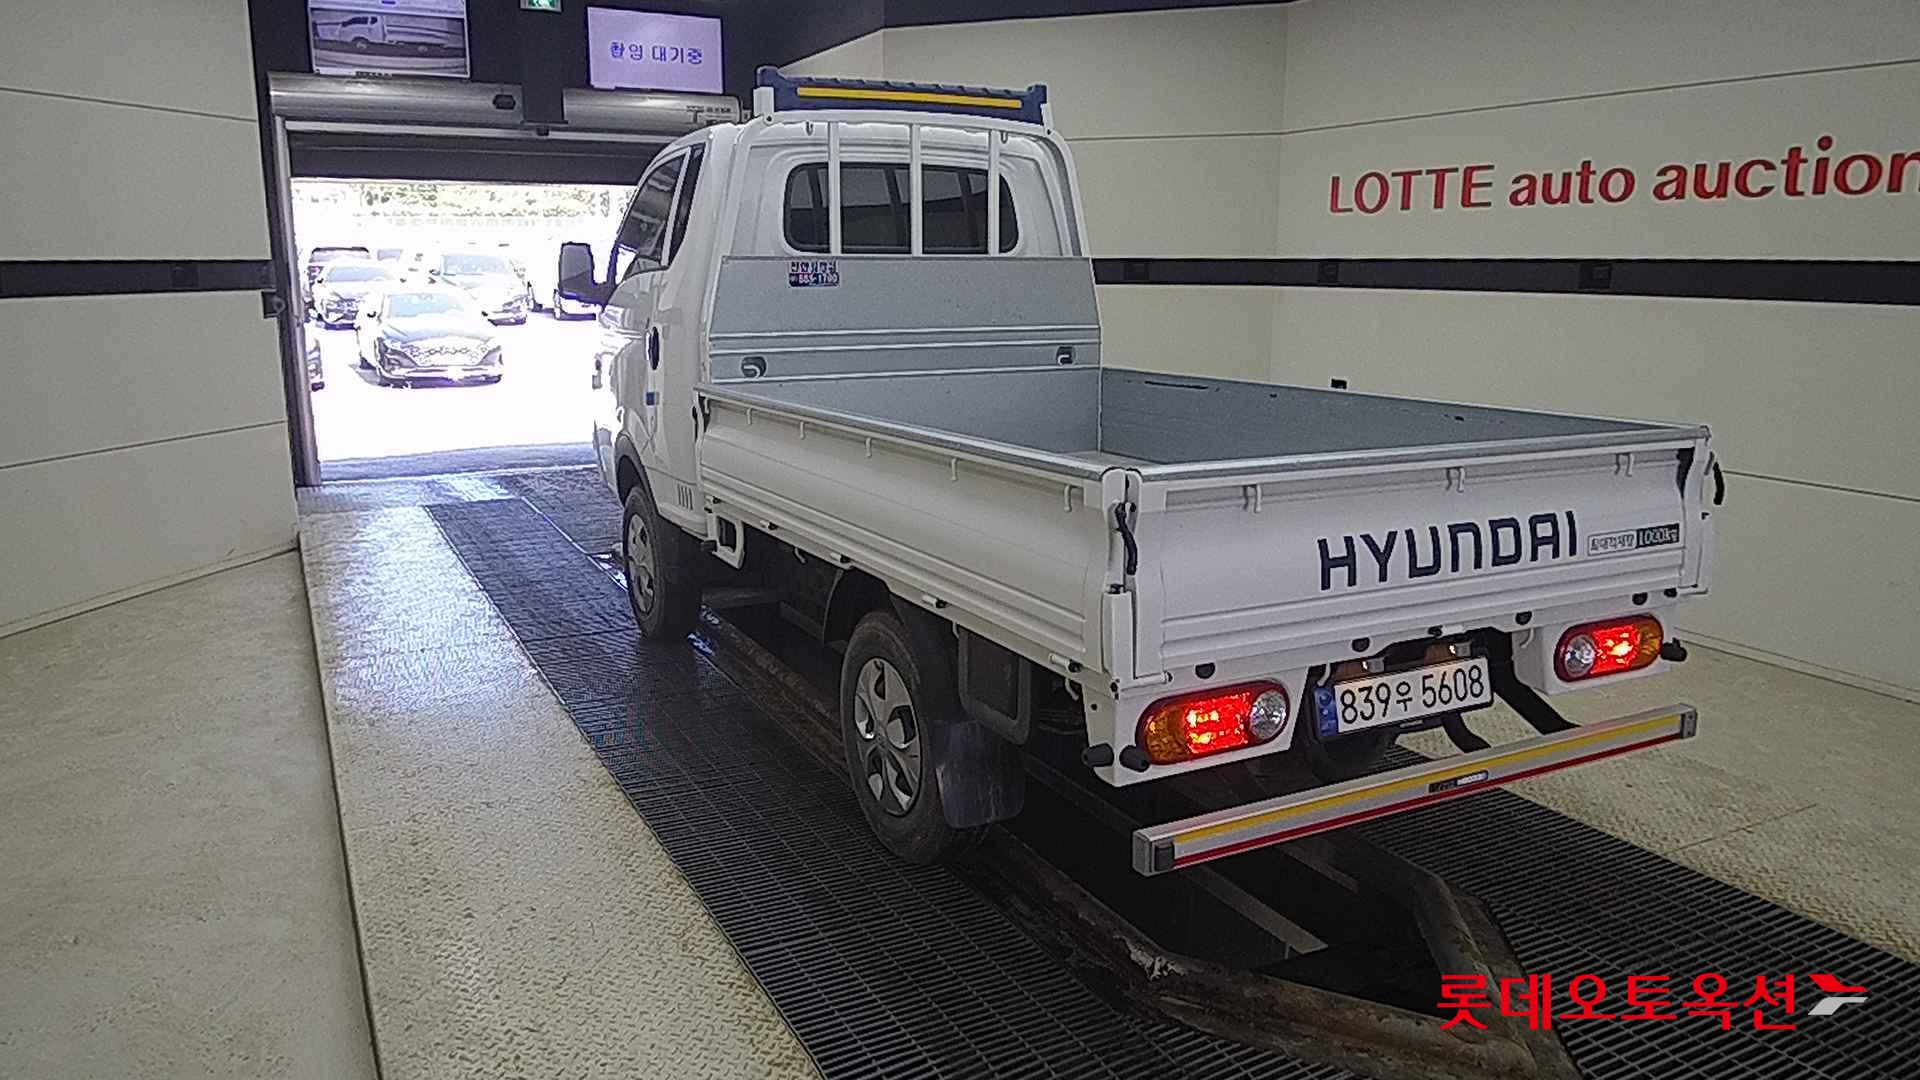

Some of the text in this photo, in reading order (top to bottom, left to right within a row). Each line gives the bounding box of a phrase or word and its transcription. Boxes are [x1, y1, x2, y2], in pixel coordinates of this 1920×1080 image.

[1330, 135, 1920, 213] LOTTE auto auction
[1317, 510, 1578, 591] HYUNDAI
[1340, 664, 1485, 724] 839우 5608
